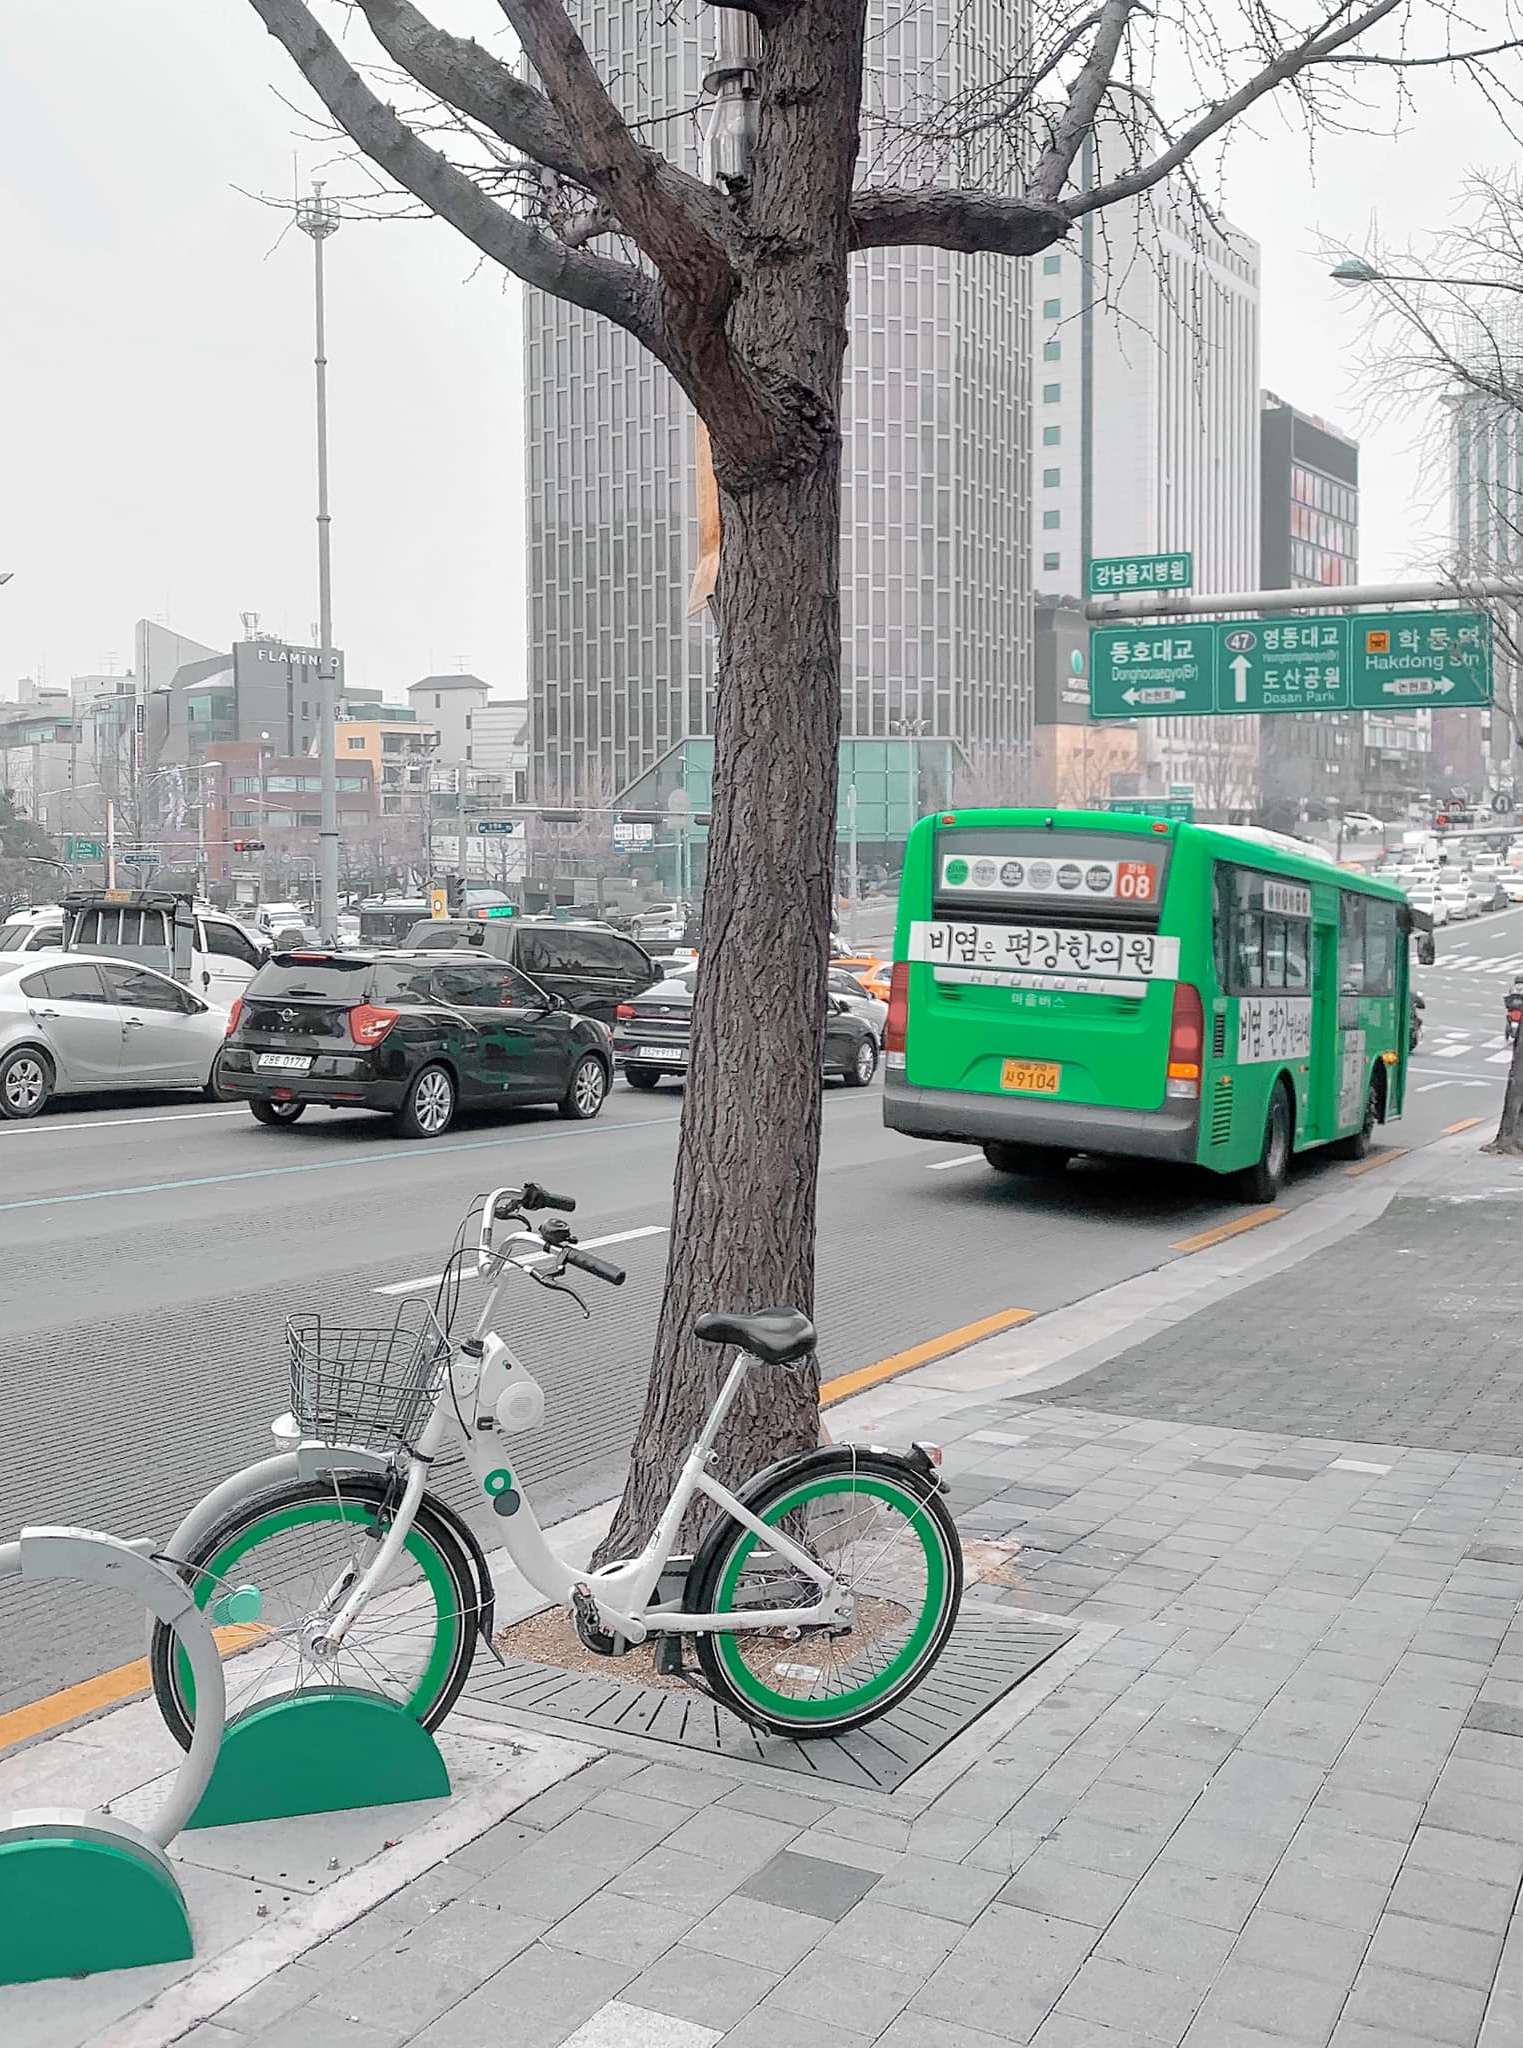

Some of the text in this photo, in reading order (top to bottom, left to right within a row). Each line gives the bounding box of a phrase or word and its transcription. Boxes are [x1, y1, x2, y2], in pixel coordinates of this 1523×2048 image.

[1096, 560, 1184, 586] 강남을지병원
[1230, 633, 1249, 649] 47
[1263, 626, 1339, 650] 영동대교
[1110, 638, 1195, 664] 동호대교
[1365, 654, 1444, 671] Hakdong
[1261, 666, 1340, 690] 도산공원
[1263, 690, 1335, 704] Dosan Park
[1119, 874, 1150, 899] 08
[930, 924, 1156, 976] 비염은 편강한의원
[1011, 992, 1066, 1009] 마을버스
